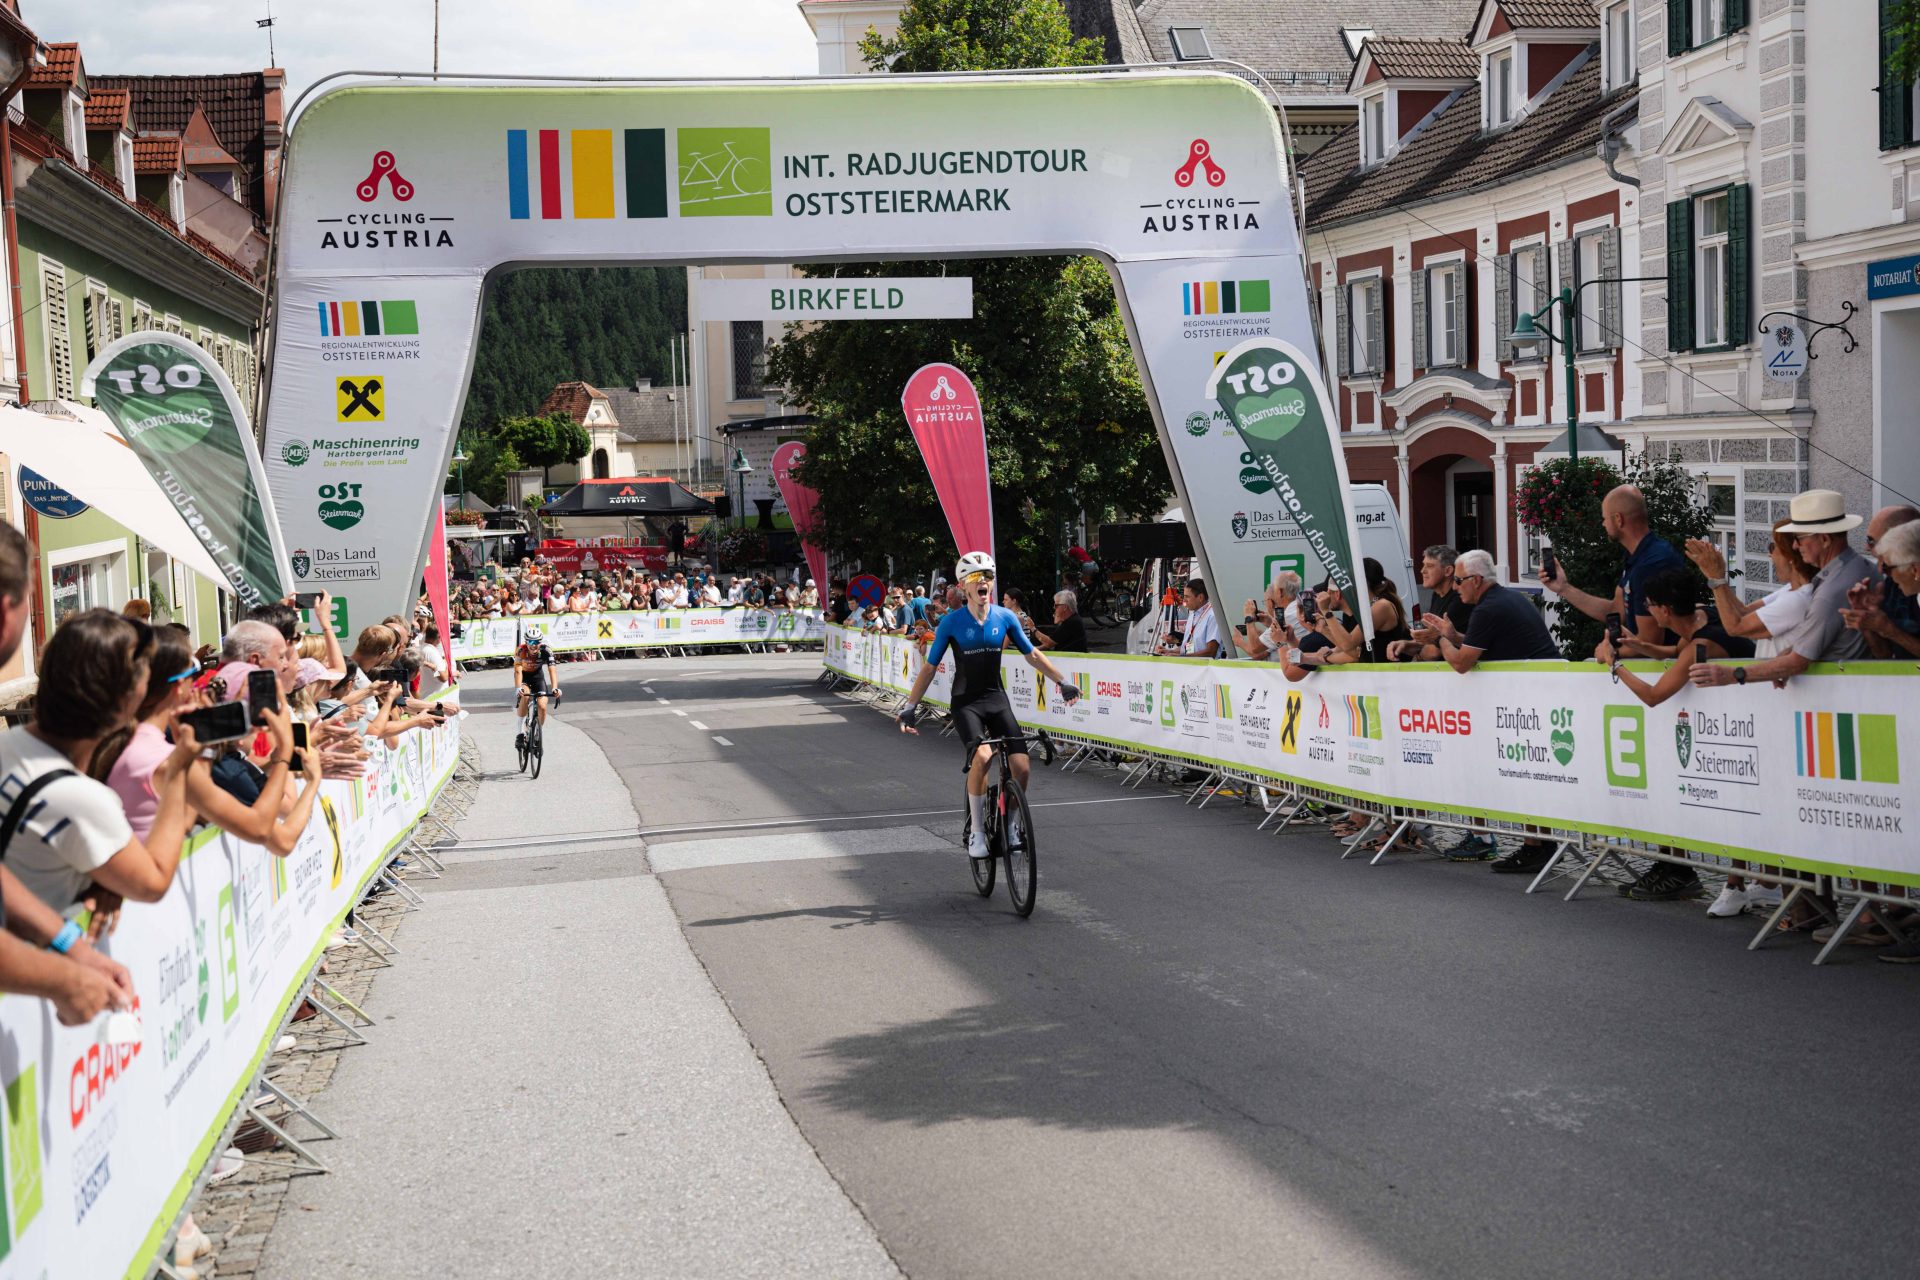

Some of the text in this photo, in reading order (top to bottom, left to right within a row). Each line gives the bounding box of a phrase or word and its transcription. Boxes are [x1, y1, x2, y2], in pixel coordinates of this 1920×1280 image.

[783, 149, 1088, 179] INT. RADJUGENDTOUR
[785, 188, 1012, 217] OSTSTEIERMARK
[1166, 197, 1235, 210] CYCLING
[347, 212, 426, 225] CYCLING
[1143, 212, 1260, 234] AUSTRIA
[321, 228, 454, 249] AUSTRIA
[1873, 269, 1912, 288] NOTARIAT
[771, 287, 905, 311] BIRKFELD
[1183, 317, 1271, 328] REGIONALENTWICKLUNG
[1183, 326, 1271, 339] OSTSTEIERMARK
[321, 340, 420, 351] REGIONALENTWICKLUNG
[322, 349, 421, 362] OSTSTEIERMARK
[1772, 369, 1799, 377] NOTAR
[312, 436, 420, 450] Maschinenring
[288, 448, 304, 457] MR
[327, 449, 405, 458] Hartbergerland
[388, 458, 408, 466] Land
[1240, 474, 1269, 486] Steierm
[318, 481, 363, 500] OST
[319, 508, 363, 520] Steiermark
[1253, 509, 1292, 522] Das La
[1251, 527, 1304, 539] Steiermar
[316, 546, 376, 561] Das Land
[314, 565, 378, 579] Steiermark
[690, 618, 725, 627] CRAISS
[1096, 681, 1122, 698] CRAISS
[1399, 708, 1472, 735] CRAISS
[1496, 706, 1574, 737] Einfach OST
[1697, 711, 1755, 739] Das Land
[1308, 746, 1335, 764] AUSTRIA
[1402, 750, 1434, 765] LOGISTIK
[1695, 750, 1757, 778] Steiermark
[1687, 783, 1719, 801] Regionen
[1797, 788, 1901, 809] REGIONALENTWICKLUNG
[1798, 807, 1903, 834] OSTSTEIERMARK
